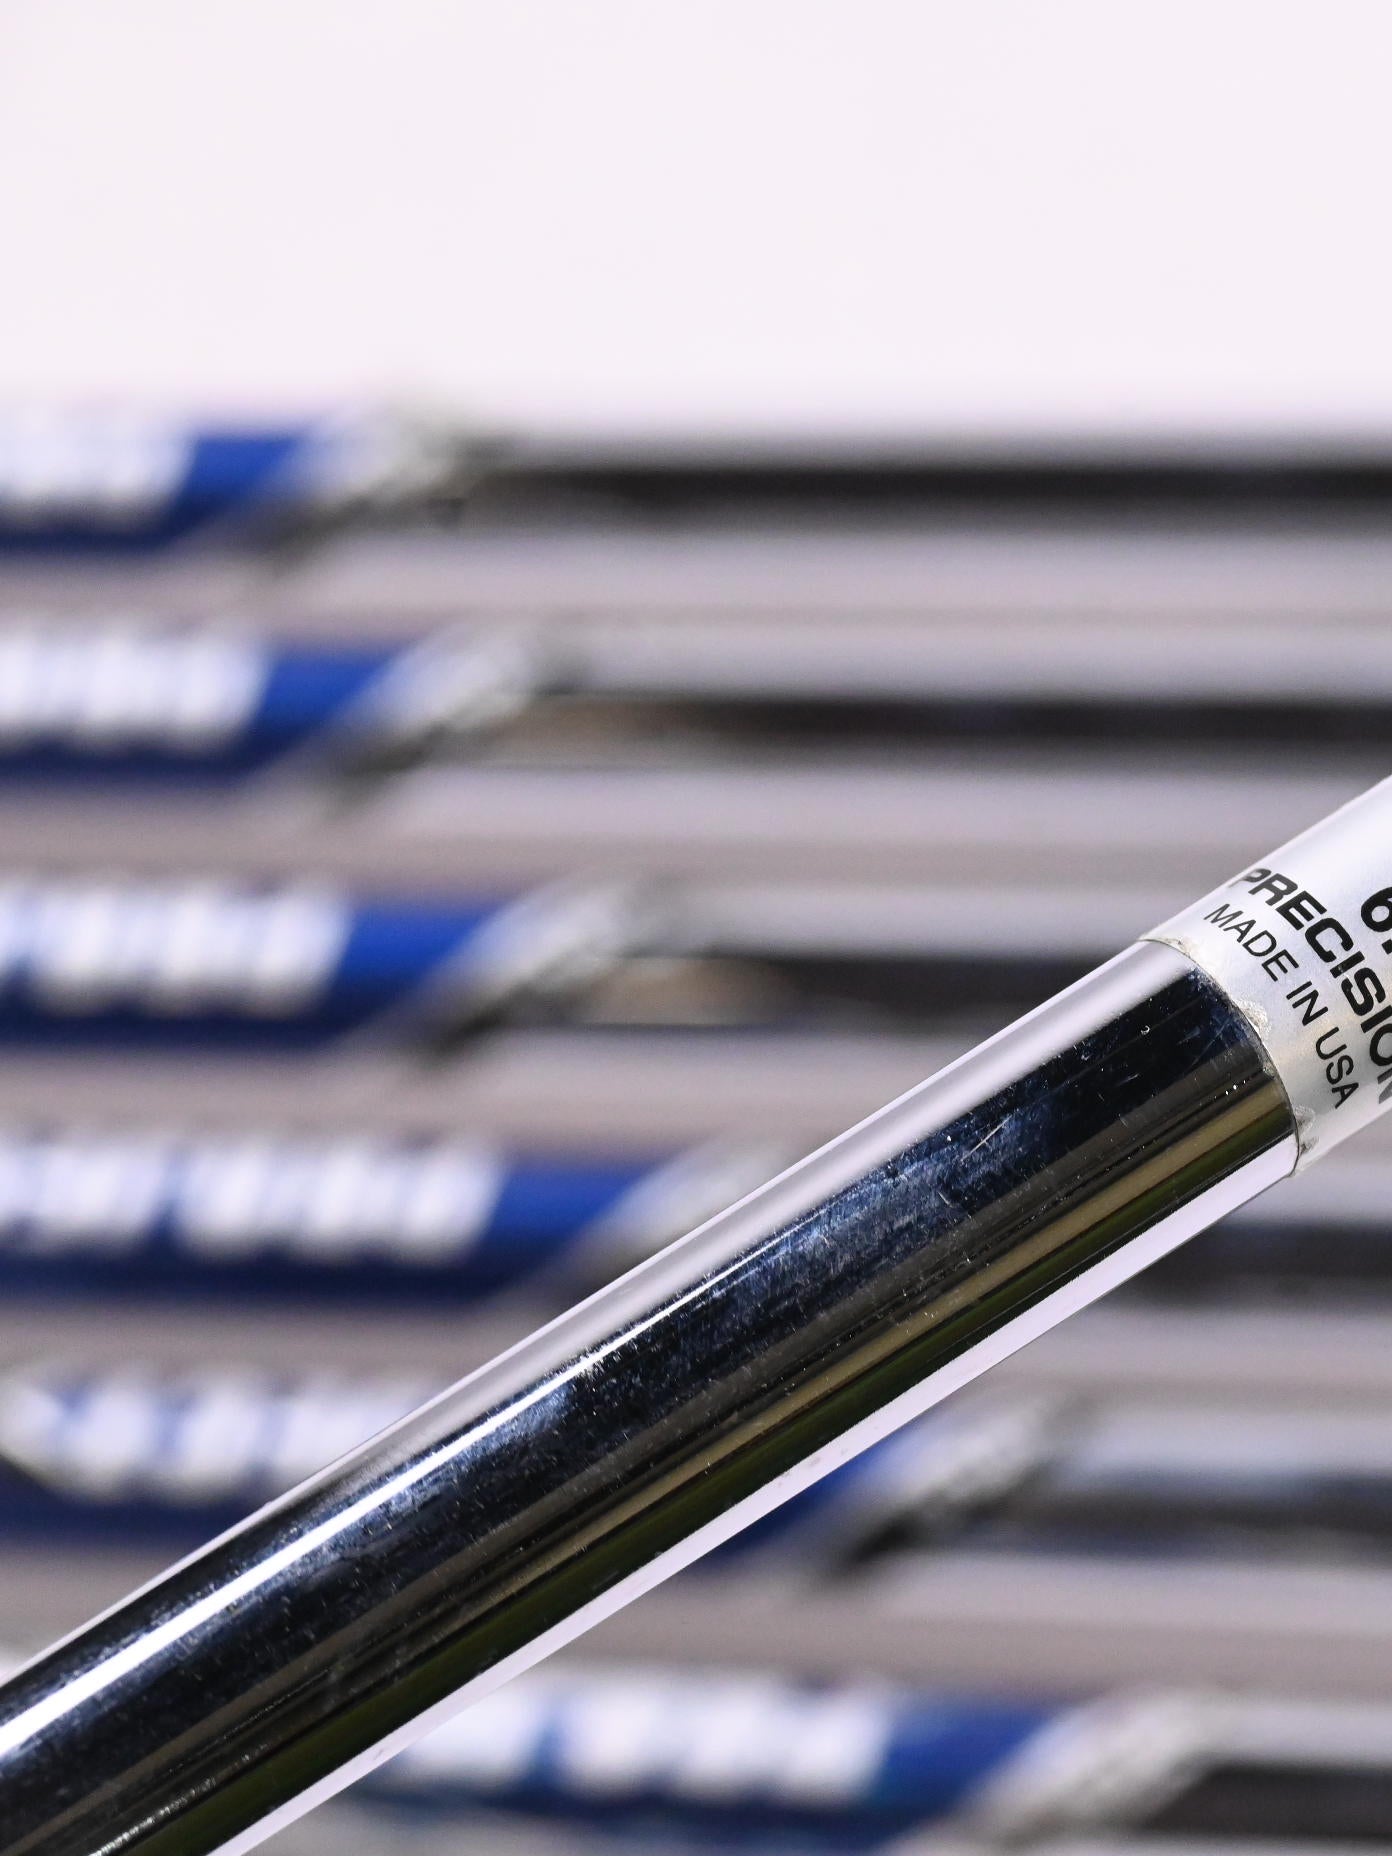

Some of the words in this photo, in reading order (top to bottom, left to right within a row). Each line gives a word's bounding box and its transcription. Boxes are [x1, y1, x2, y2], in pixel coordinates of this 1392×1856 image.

[1203, 902, 1300, 983] MADE
[1285, 980, 1329, 1027] IN
[1314, 1026, 1361, 1110] USA
